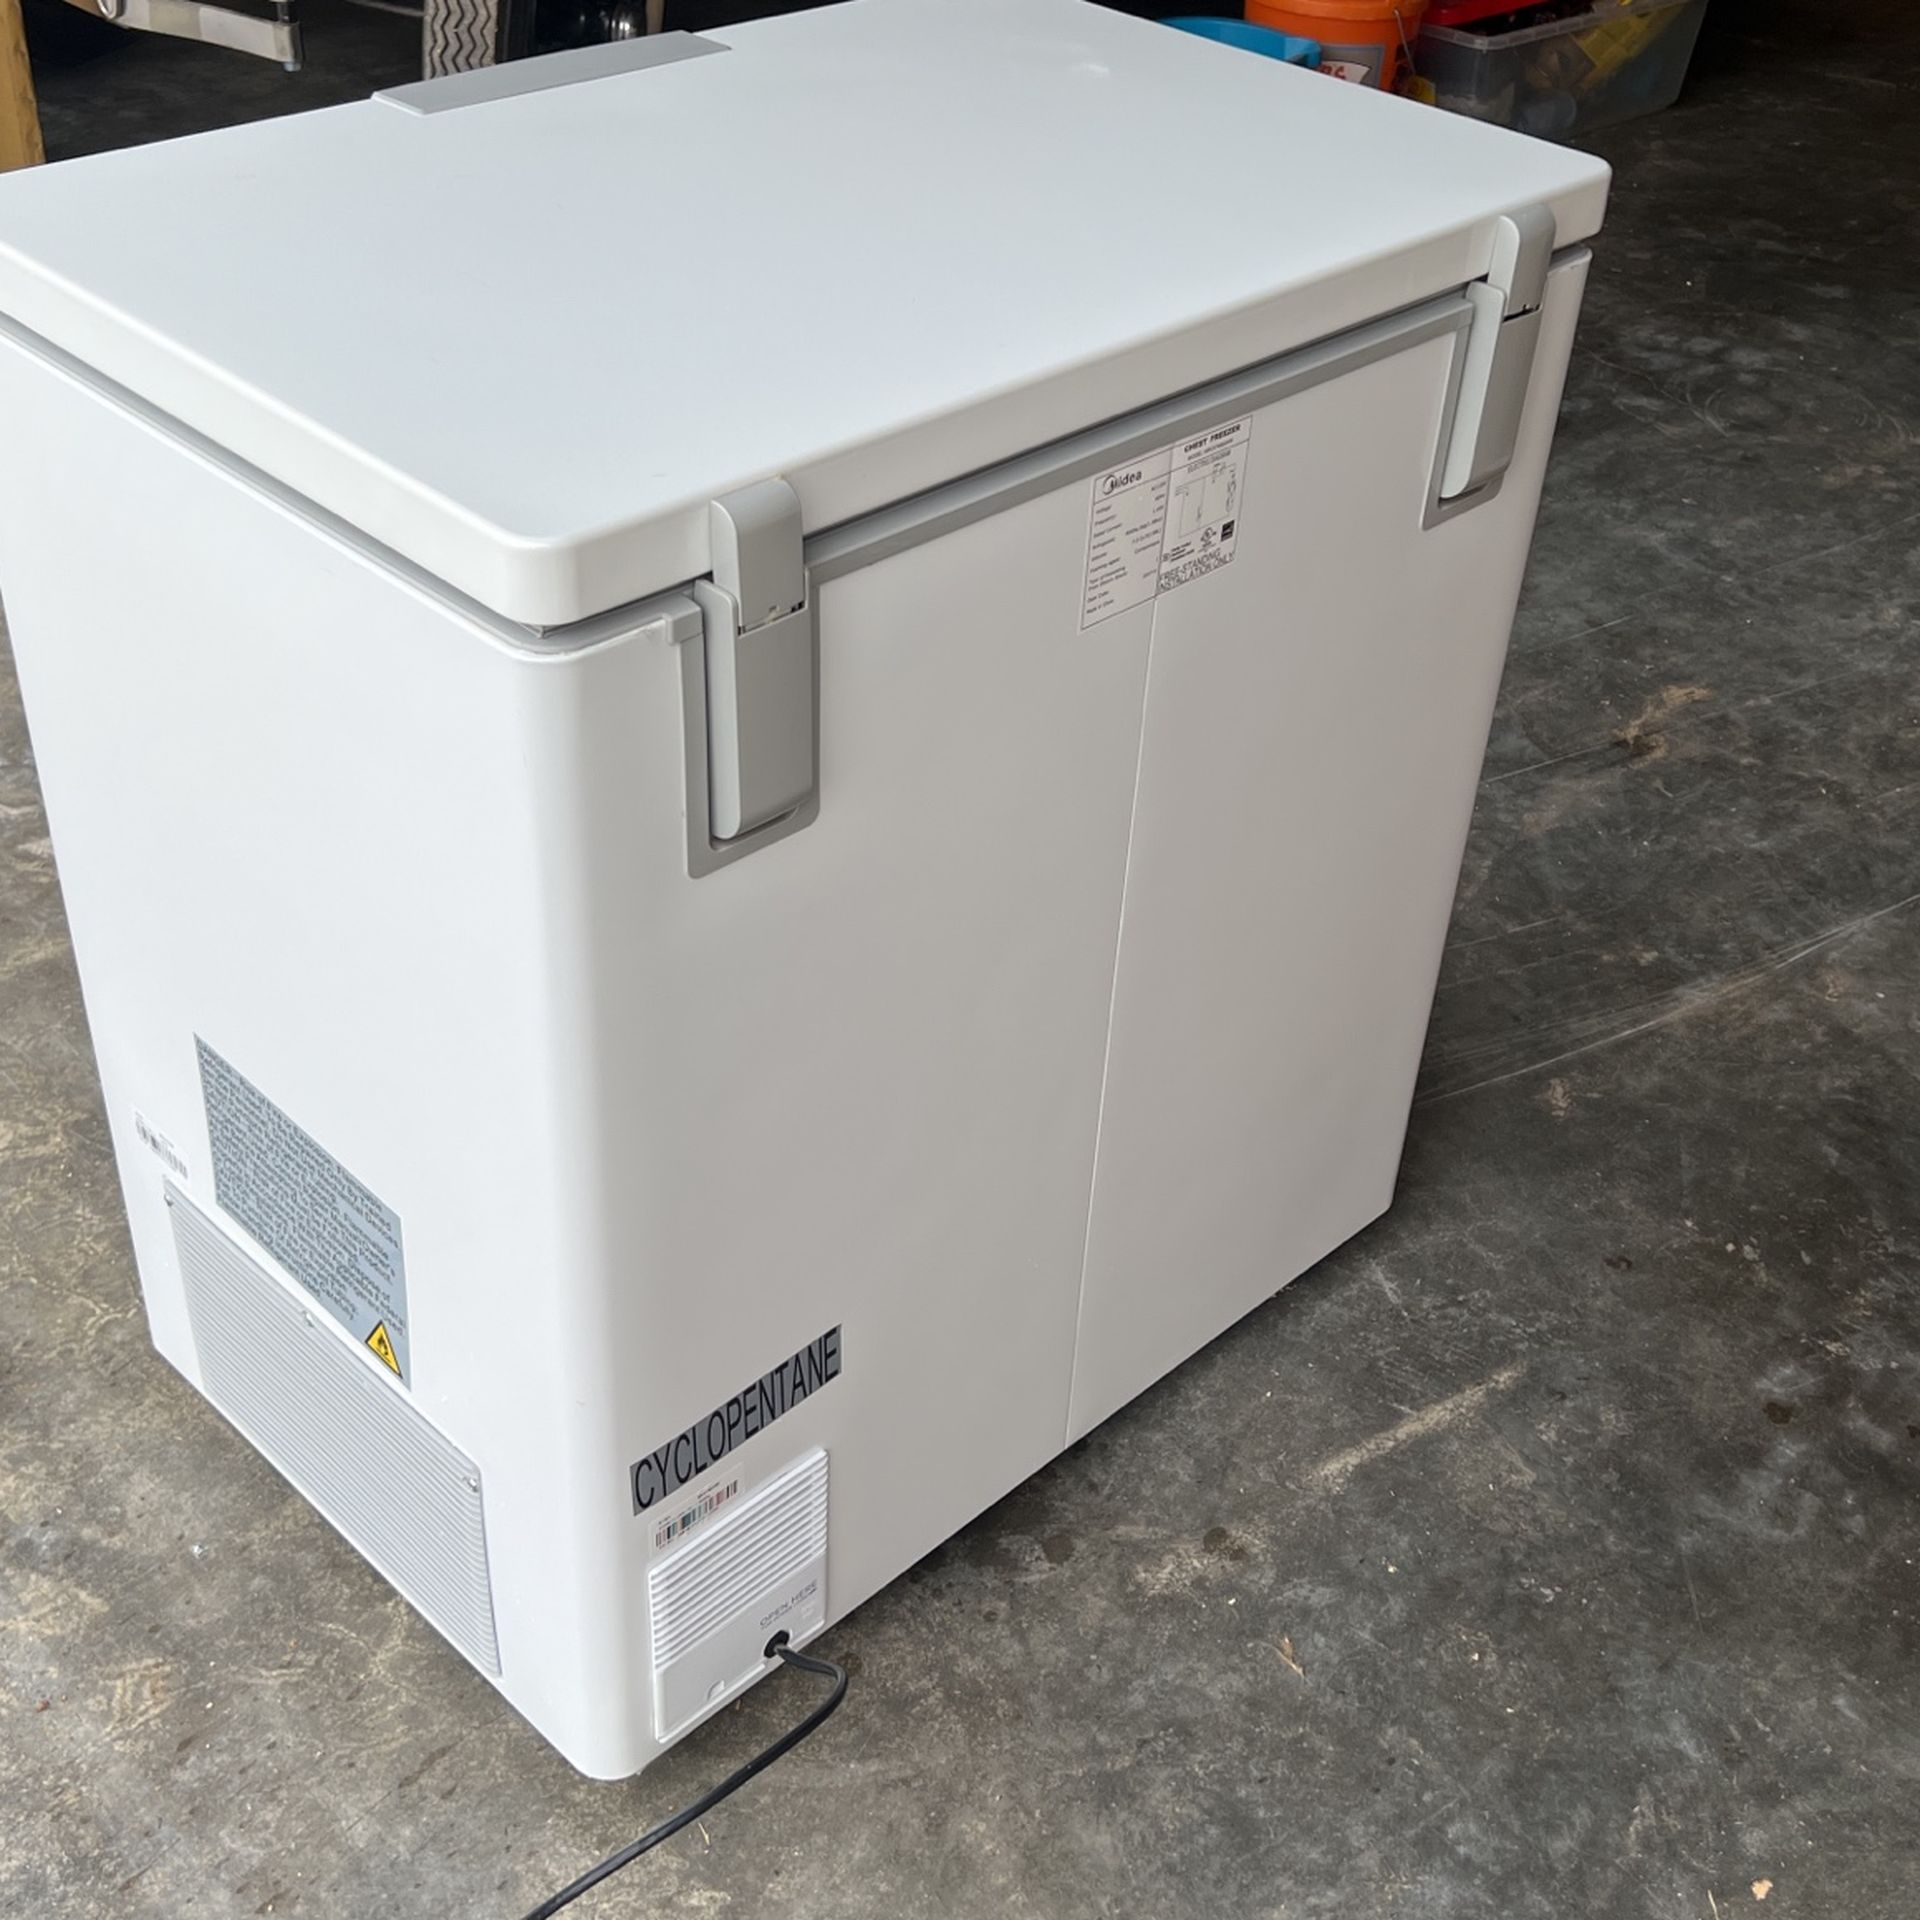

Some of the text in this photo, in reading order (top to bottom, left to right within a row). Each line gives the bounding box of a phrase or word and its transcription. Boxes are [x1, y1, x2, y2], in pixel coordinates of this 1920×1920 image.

[1184, 438, 1208, 453] CHEST
[1210, 424, 1241, 442] FREEZER
[1103, 471, 1142, 494] Midea
[635, 1326, 839, 1509] CYCLOPENTANE
